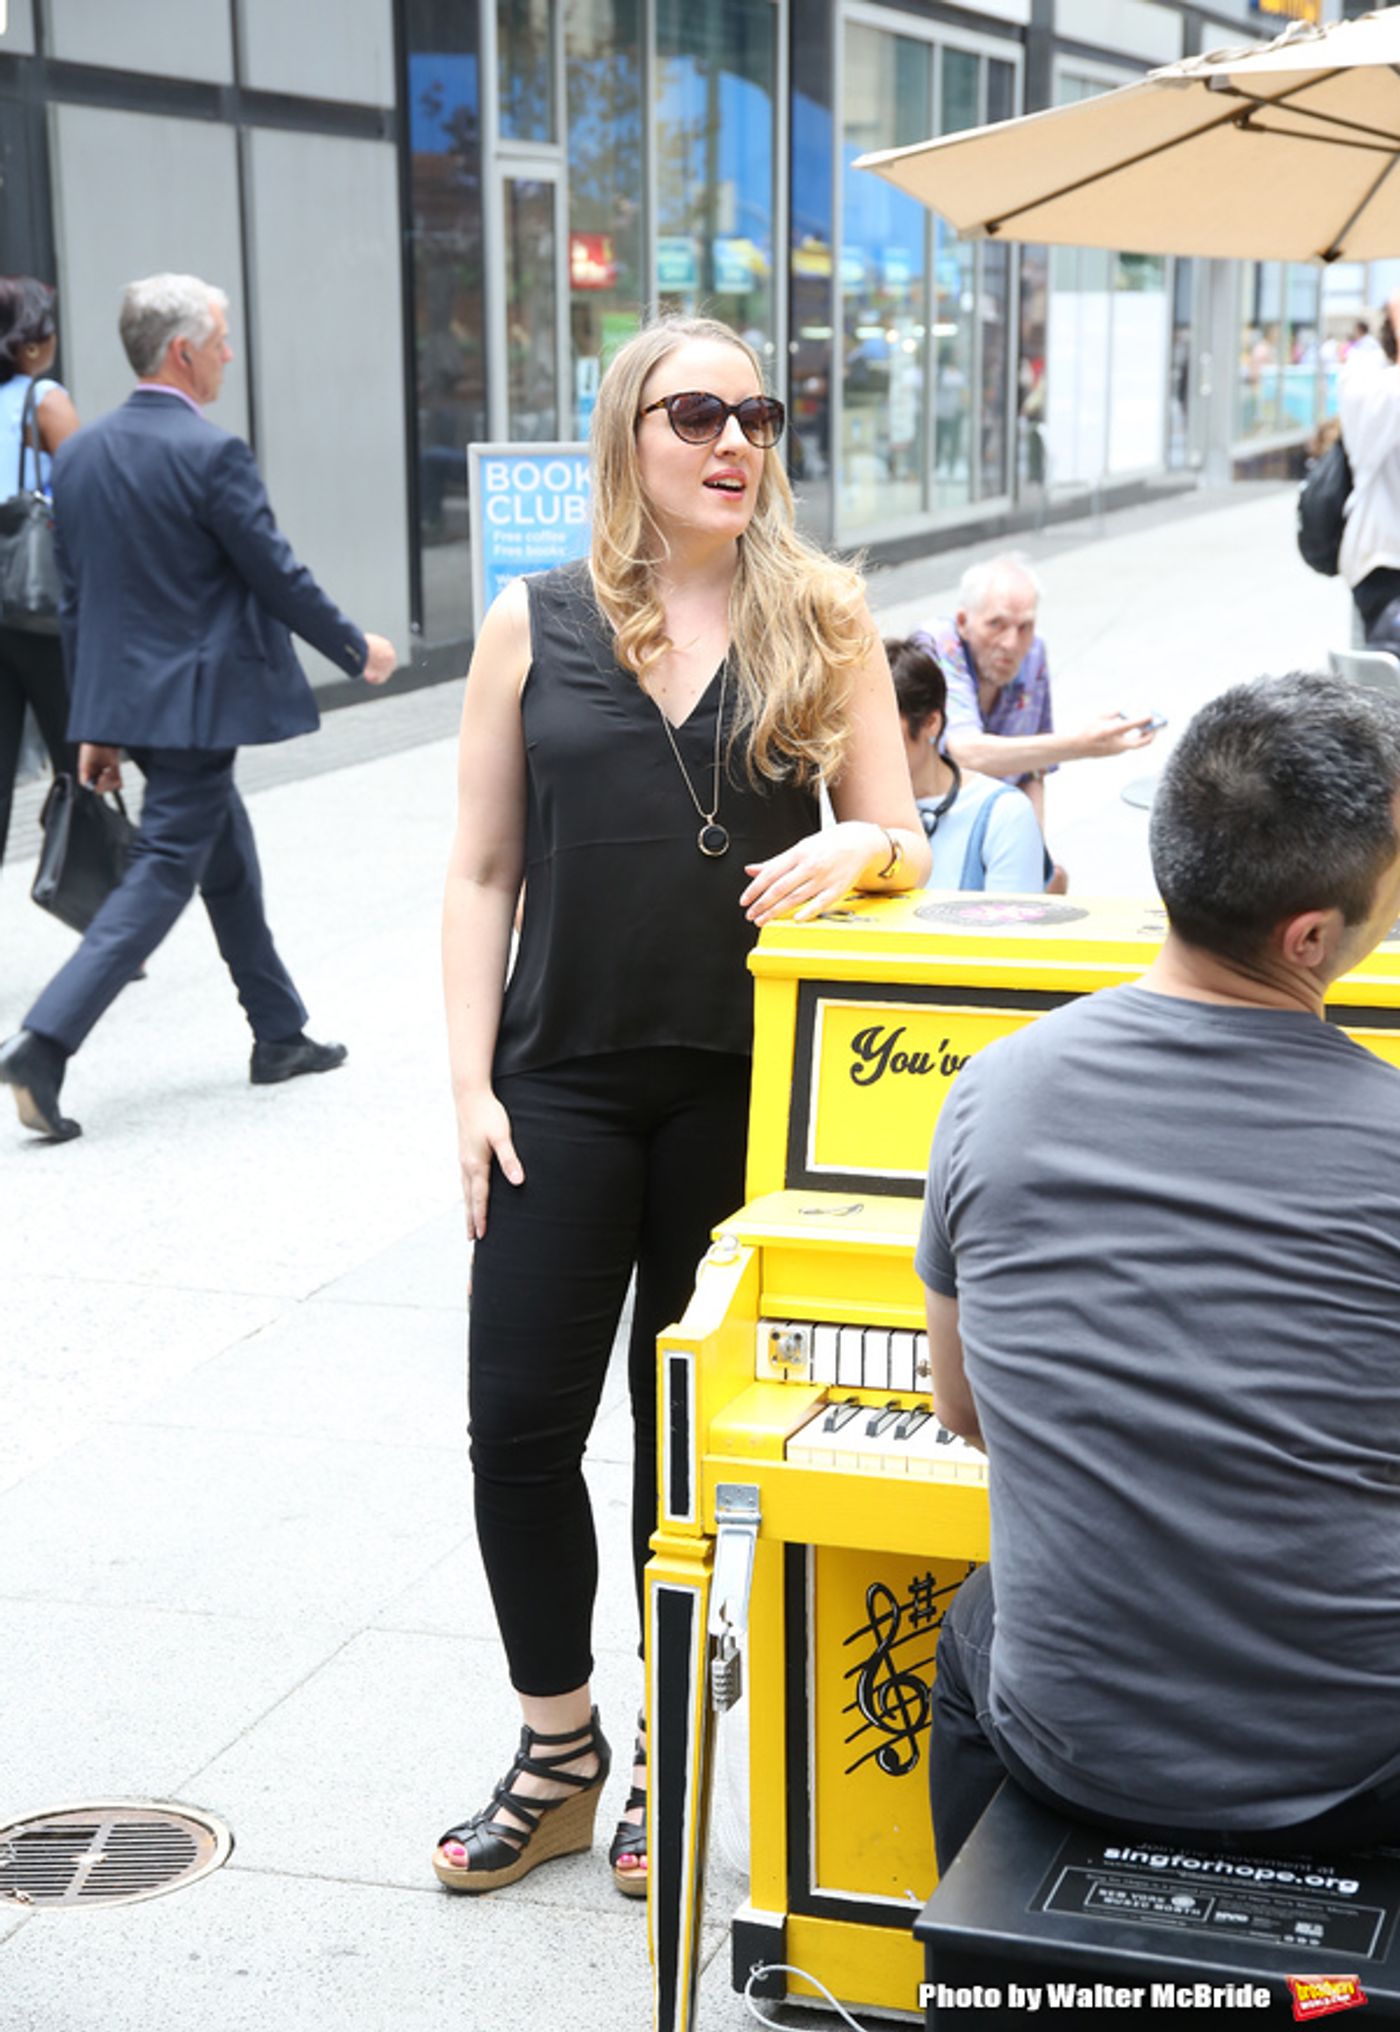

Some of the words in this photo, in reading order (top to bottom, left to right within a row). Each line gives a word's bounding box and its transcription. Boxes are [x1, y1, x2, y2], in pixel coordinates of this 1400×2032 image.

[485, 461, 591, 492] BOOK
[486, 494, 586, 525] CLUB
[493, 531, 522, 543] Free
[525, 530, 567, 543] coffee
[493, 544, 522, 556] Free
[1103, 1847, 1360, 1895] singforhope.org
